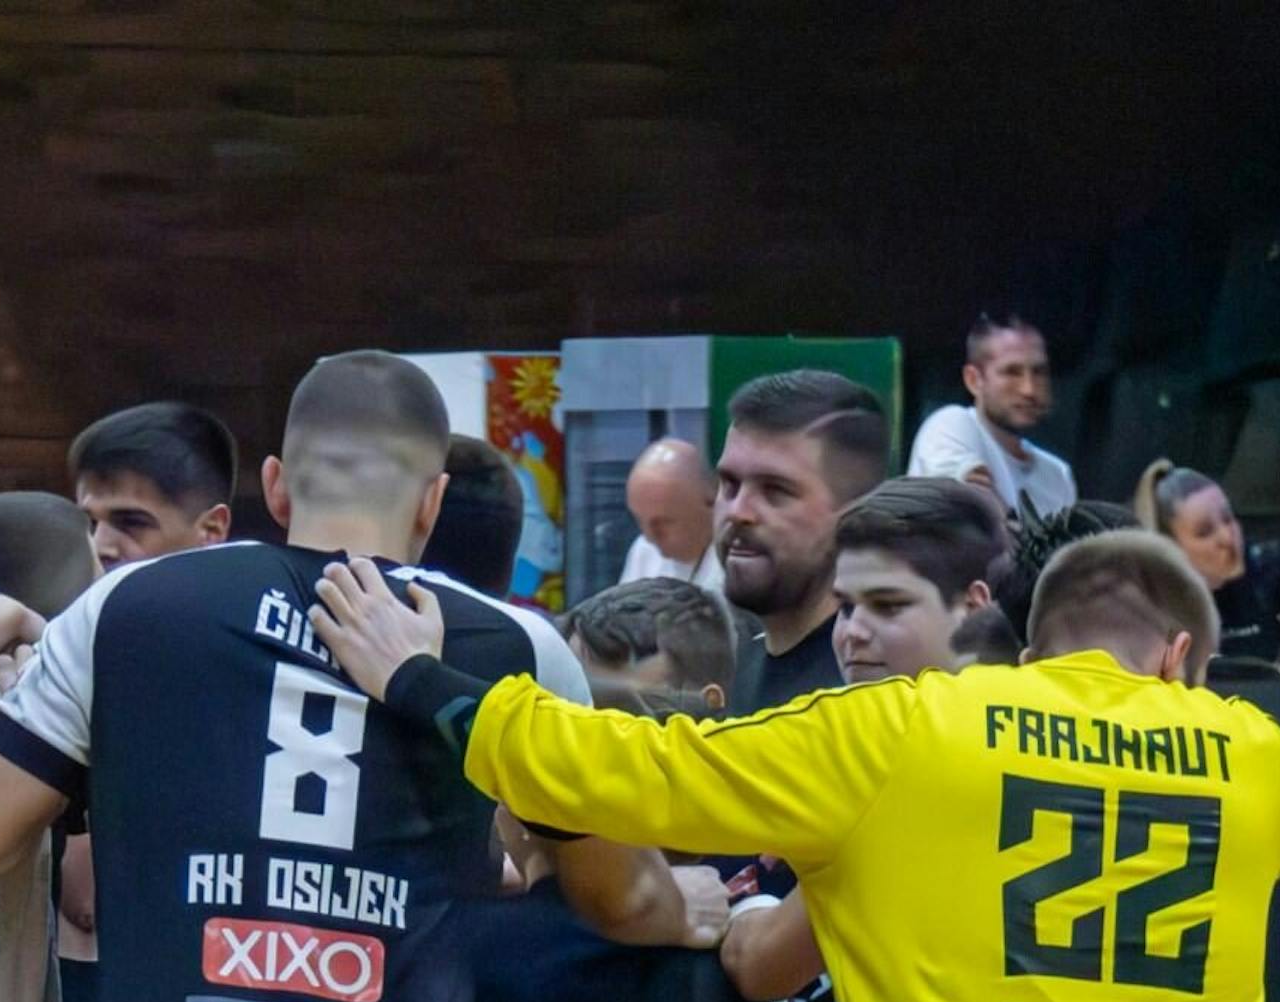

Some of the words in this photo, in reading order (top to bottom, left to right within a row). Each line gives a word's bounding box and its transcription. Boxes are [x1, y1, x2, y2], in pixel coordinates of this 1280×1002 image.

[259, 661, 369, 851] 8
[986, 705, 1231, 781] FRAJHAUT
[188, 855, 243, 904] RK
[267, 858, 409, 929] OSIJEK
[998, 773, 1222, 994] 22
[219, 928, 372, 995] XIXO
